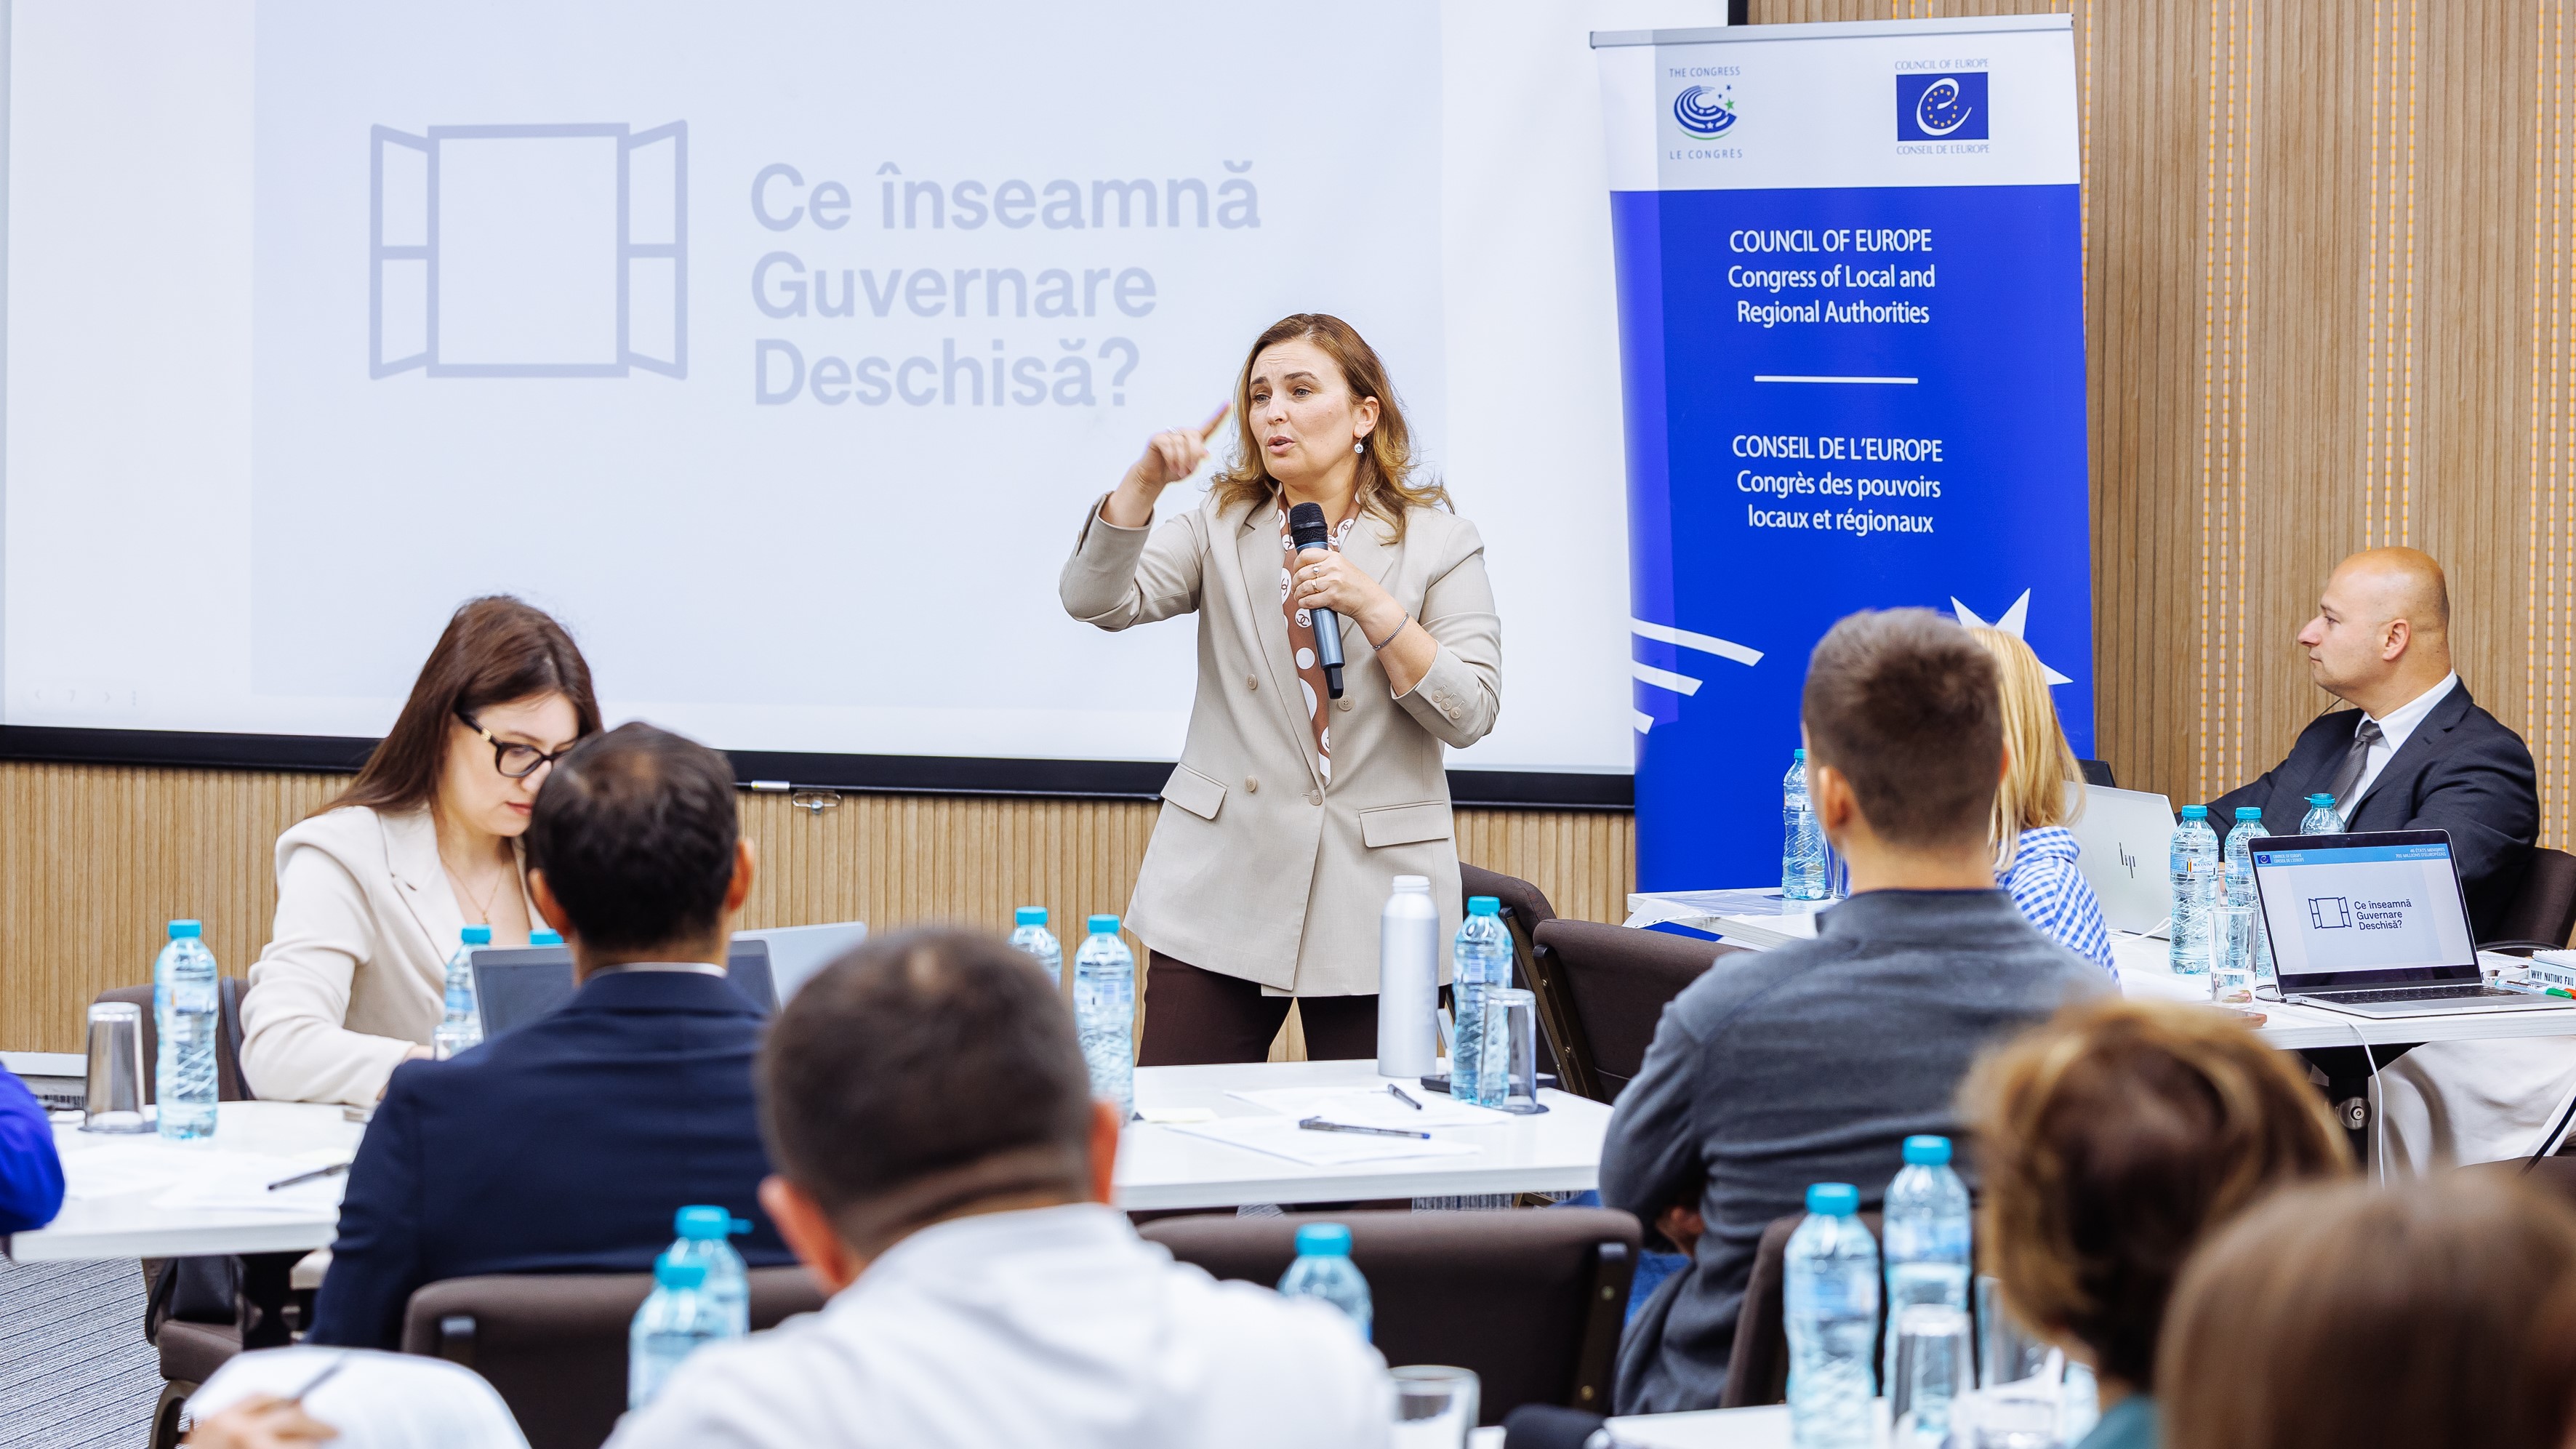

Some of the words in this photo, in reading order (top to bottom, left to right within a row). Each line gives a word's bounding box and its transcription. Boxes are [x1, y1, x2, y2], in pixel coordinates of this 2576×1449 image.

[1669, 68, 1687, 78] THE
[1690, 66, 1741, 77] CONGRESS
[1895, 60, 1936, 71] COUNCIL
[1938, 60, 1951, 69] OF
[1955, 58, 1989, 68] EUROPE
[1669, 150, 1681, 159] LE
[1688, 148, 1743, 159] CONGRÈS
[1896, 145, 1934, 155] CONSEIL
[1935, 145, 1949, 154] DE
[1951, 144, 1990, 153] L'EUROPE
[750, 162, 851, 232] Ce
[875, 159, 1261, 230] înseamnă
[1729, 230, 1819, 253] COUNCIL
[1823, 230, 1850, 252] OF
[1855, 229, 1933, 252] EUROPE
[751, 250, 1157, 319] Guvernare
[1728, 265, 1816, 294] Congress
[1821, 264, 1842, 288] of
[1845, 265, 1896, 288] Local
[1899, 265, 1935, 289] and
[1737, 300, 1820, 329] Regional
[1824, 300, 1930, 324] Authorities
[755, 336, 1140, 406] Deschisă?
[1732, 435, 1815, 459] CONSEIL
[1819, 437, 1846, 460] DE
[1736, 470, 1815, 498] Congrès
[1819, 472, 1853, 496] des
[1858, 474, 1941, 502] pouvoirs
[1748, 505, 1809, 529] locaux
[1813, 509, 1832, 530] et
[1836, 507, 1934, 537] régionaux
[2354, 901, 2367, 910] Ce
[2368, 899, 2412, 910] înseamnă
[2356, 910, 2403, 920] Guvernare
[2359, 920, 2402, 931] Deschisă?
[2531, 970, 2542, 980] WHY
[2545, 972, 2562, 984] NATIONS
[2564, 976, 2574, 986] FAIL
